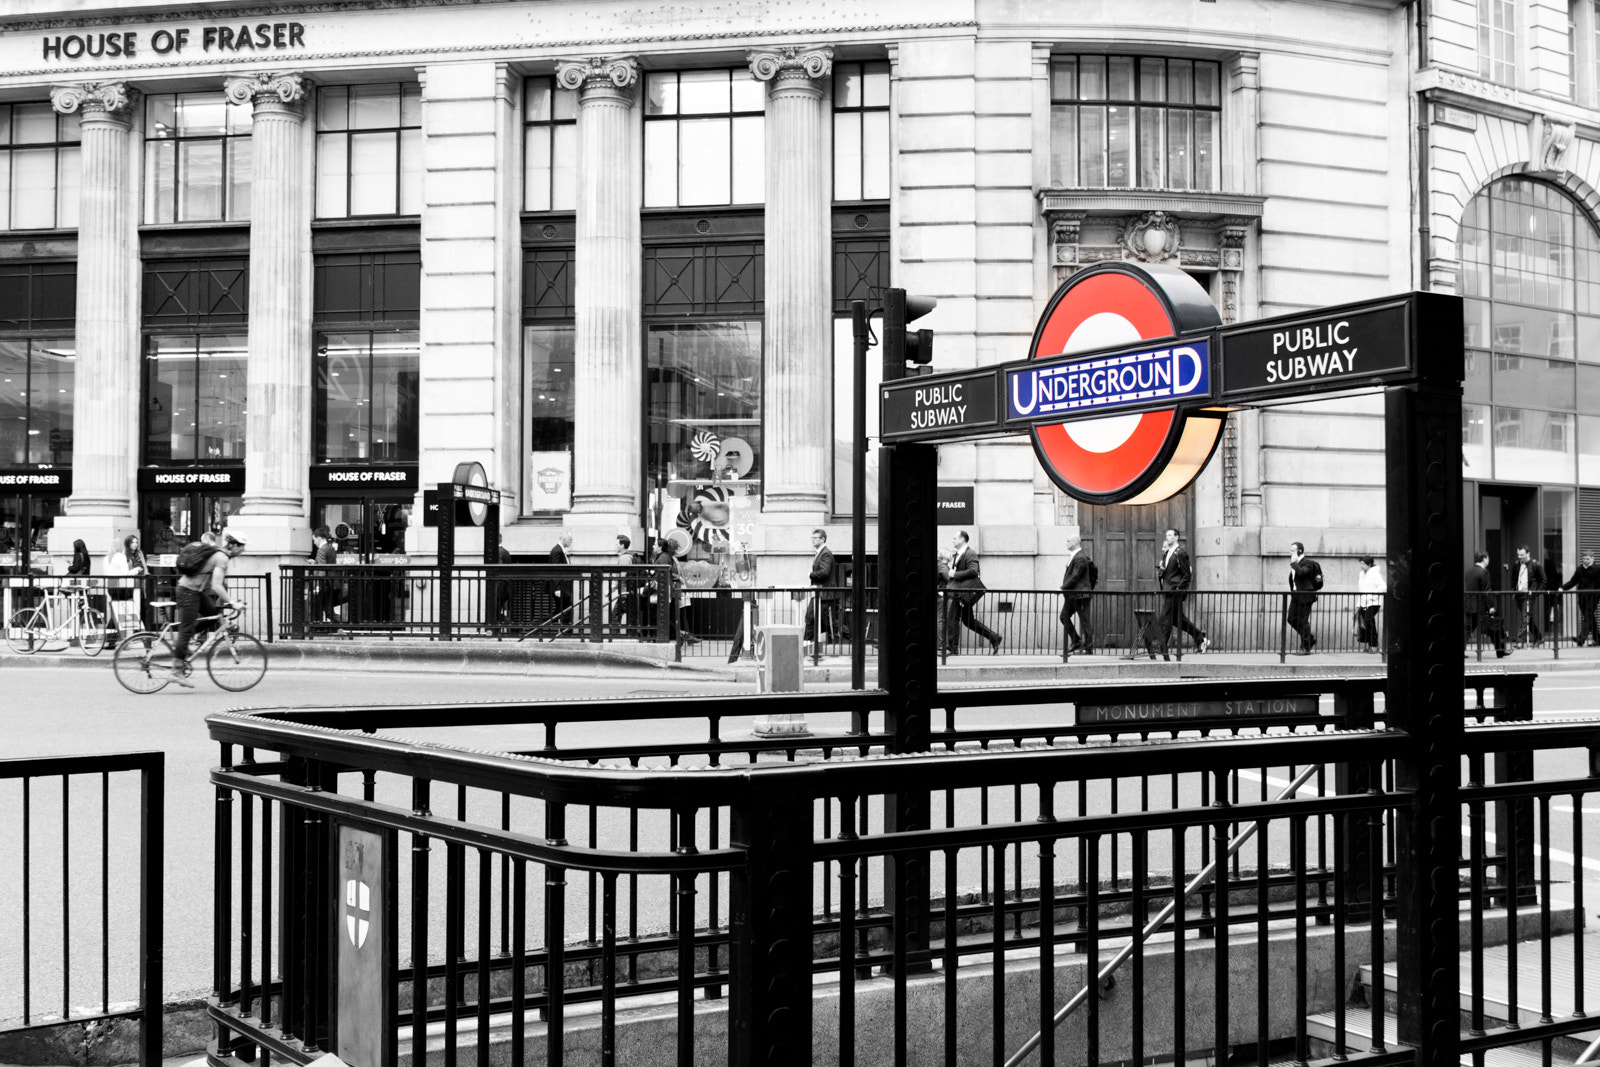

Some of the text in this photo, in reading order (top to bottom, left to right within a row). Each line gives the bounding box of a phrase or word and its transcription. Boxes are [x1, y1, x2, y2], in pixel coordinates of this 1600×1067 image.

[43, 22, 306, 61] HOUSE OF FRASER
[1273, 321, 1350, 355] PUBLIC
[1266, 347, 1358, 383] SUBWAY
[1012, 346, 1202, 415] UNDERGROUND
[915, 383, 962, 407] PUBLIC
[910, 404, 967, 429] SUBWAY
[0, 475, 60, 484] USE OF FRASER
[155, 473, 231, 484] HOUSE OF FRASER
[328, 471, 406, 482] HOUSE OF FRASER
[942, 501, 966, 509] FRASER
[1096, 700, 1297, 721] MONUMENT STATION
